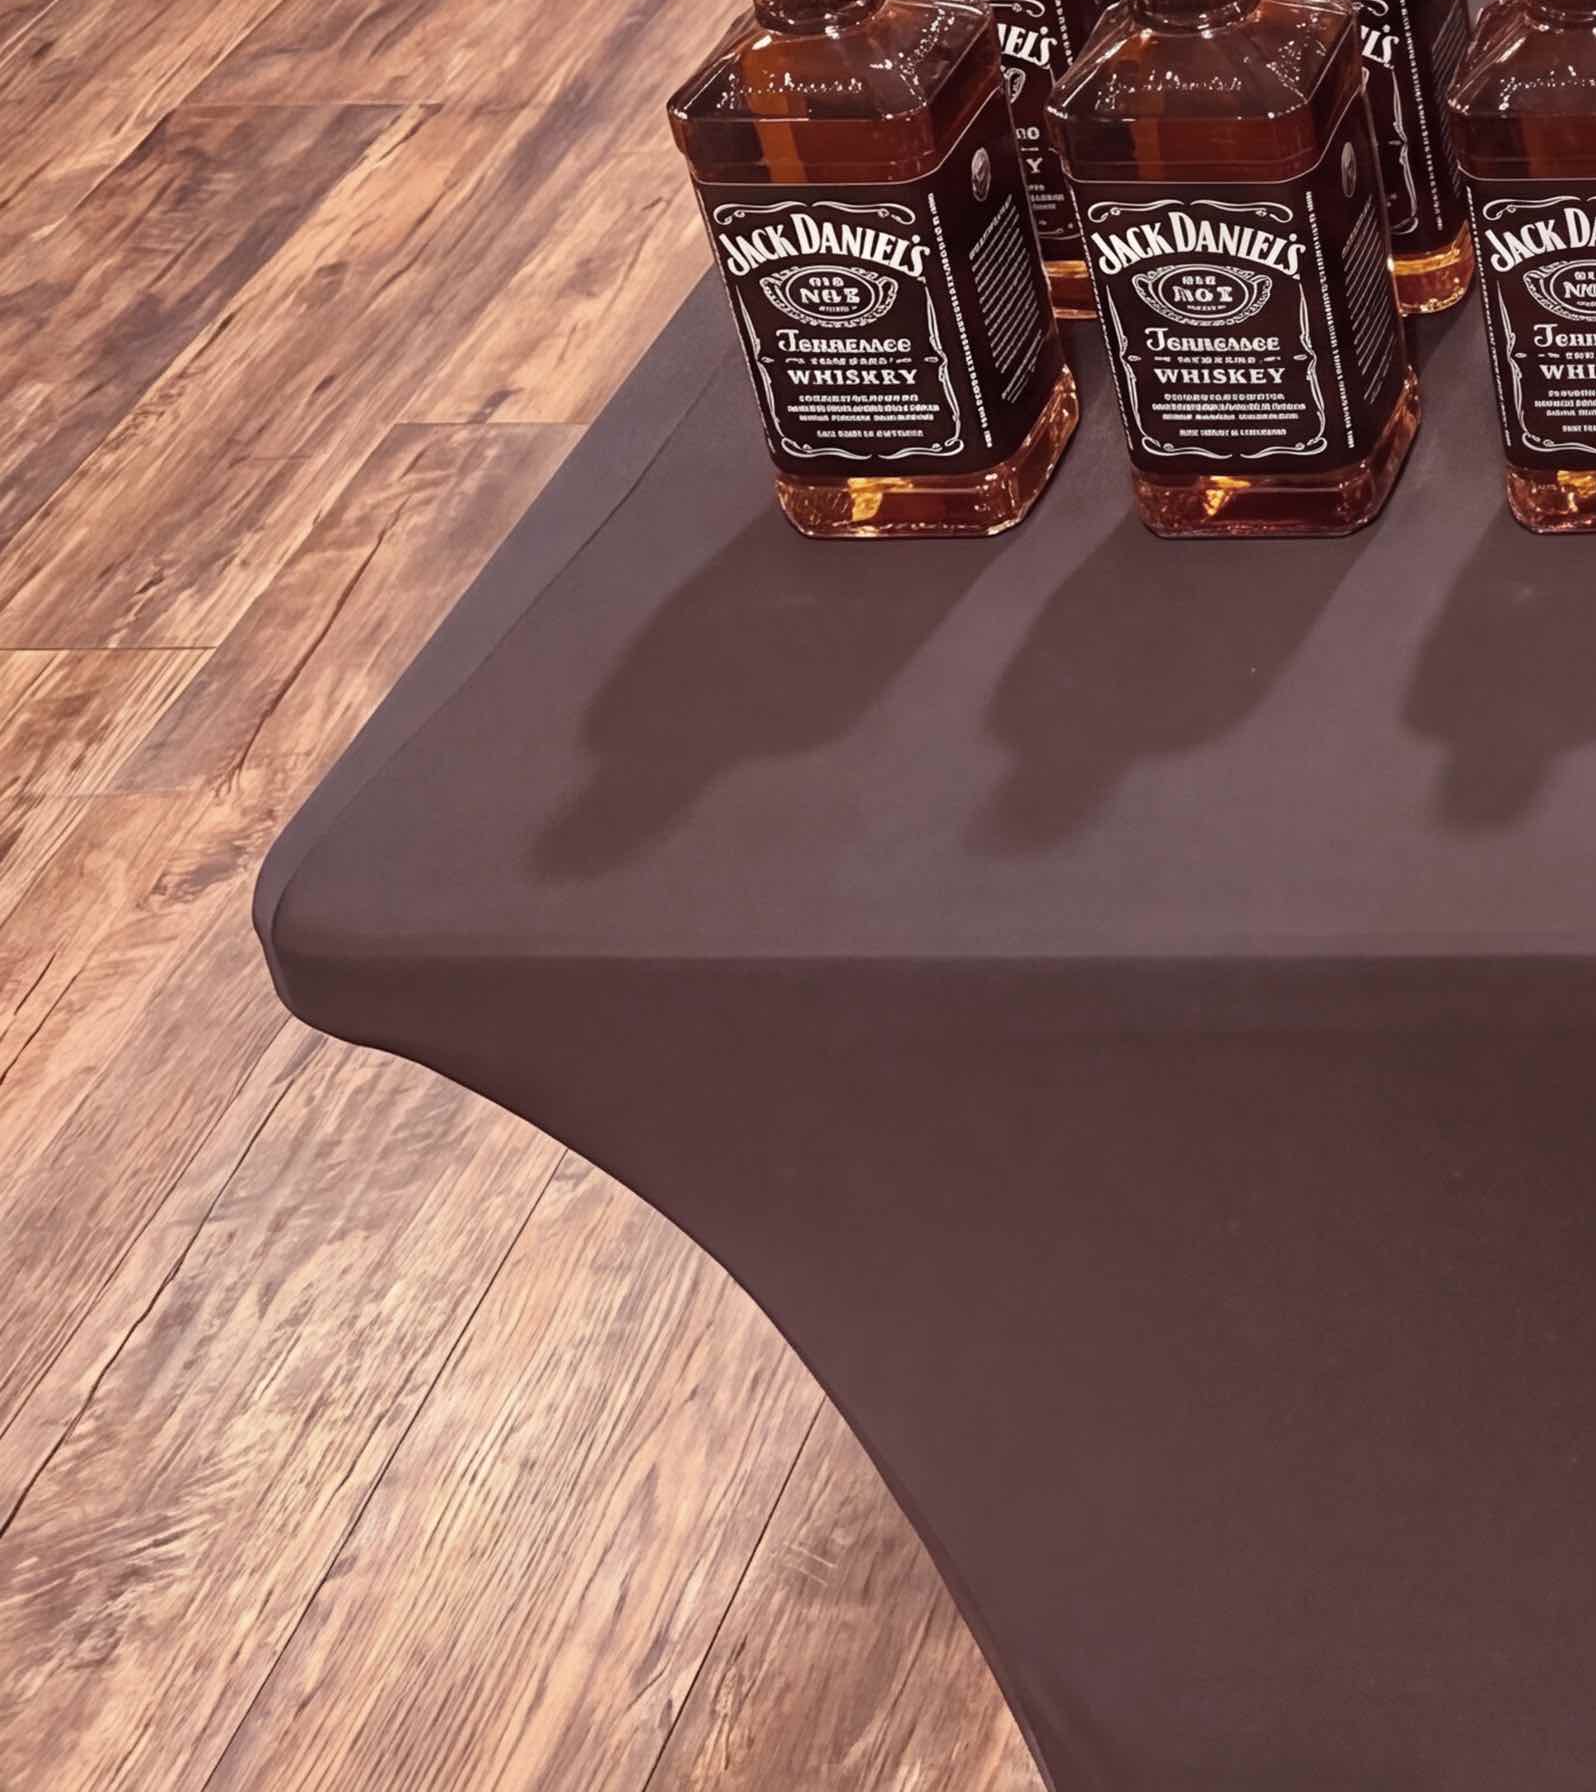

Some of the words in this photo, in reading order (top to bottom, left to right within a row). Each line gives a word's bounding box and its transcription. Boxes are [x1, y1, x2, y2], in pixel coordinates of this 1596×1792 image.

[719, 224, 799, 277] JACK
[790, 213, 931, 277] DANIEL'S
[1091, 222, 1174, 275] JACK
[1169, 212, 1306, 279] DANIEL'S
[1484, 219, 1568, 272] JACK
[1154, 367, 1286, 385] WHISKEY
